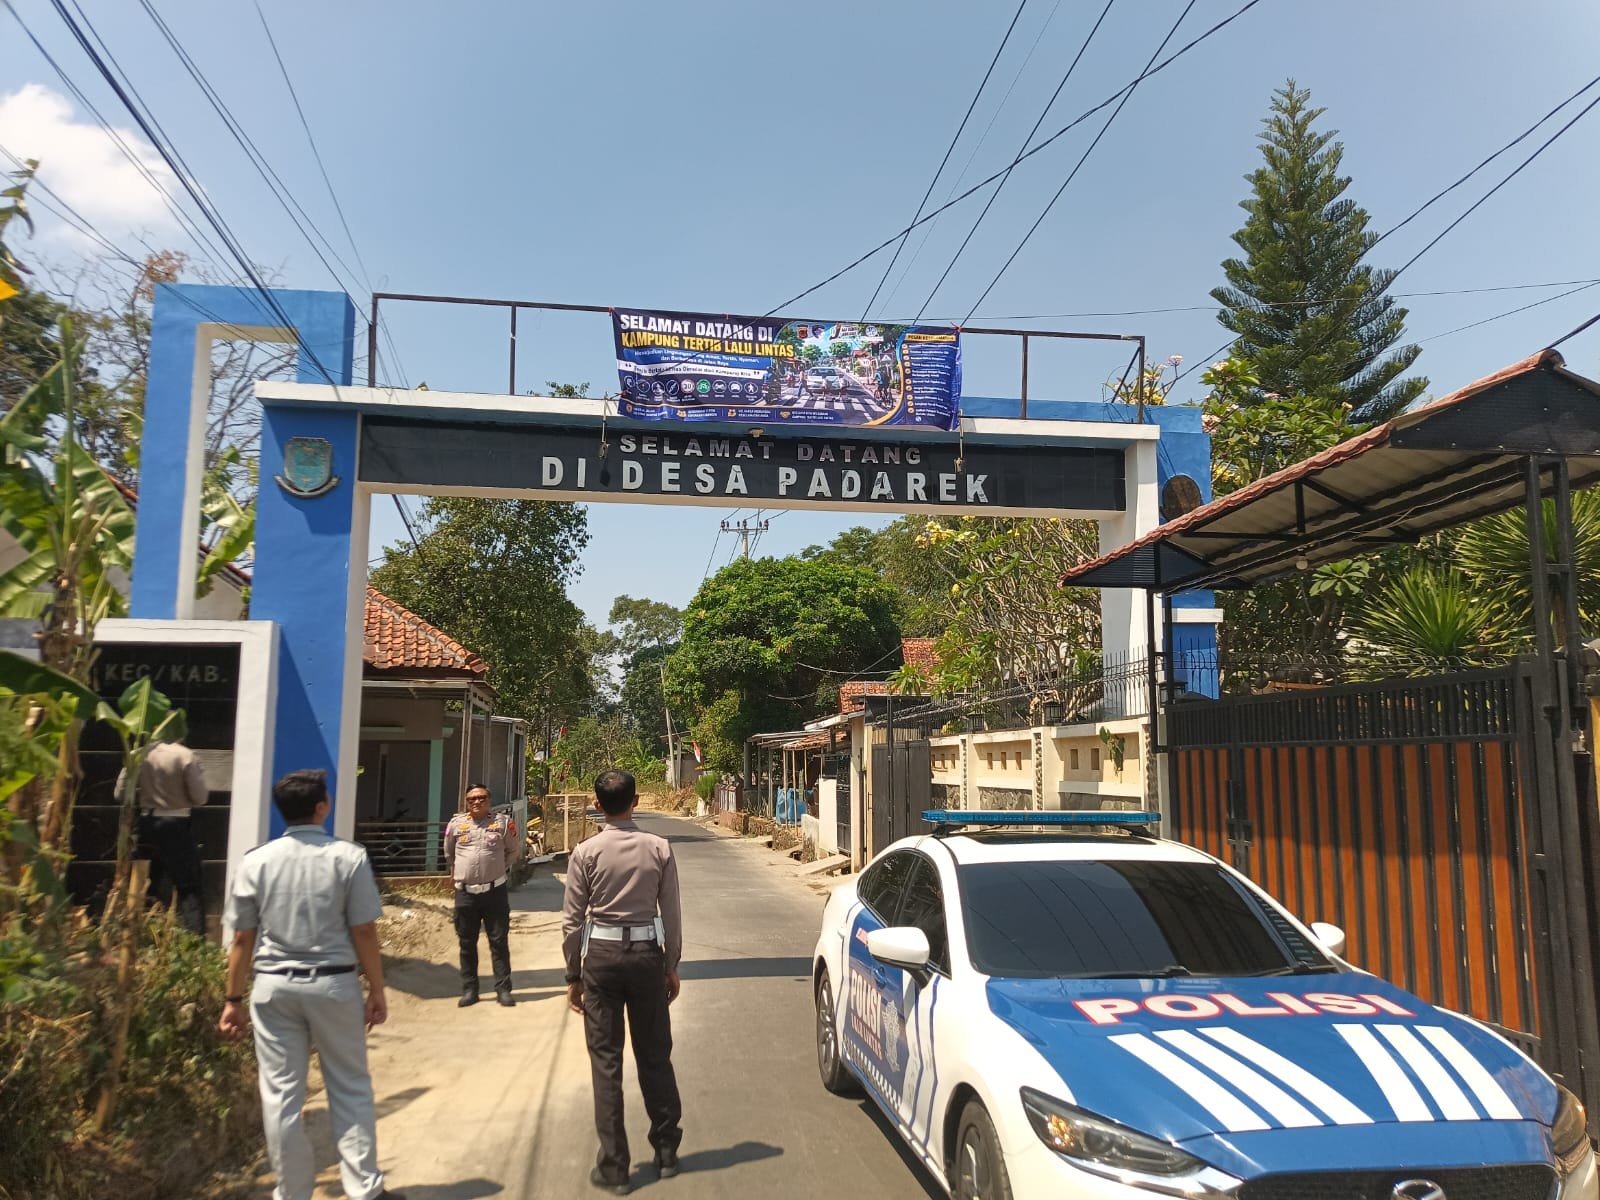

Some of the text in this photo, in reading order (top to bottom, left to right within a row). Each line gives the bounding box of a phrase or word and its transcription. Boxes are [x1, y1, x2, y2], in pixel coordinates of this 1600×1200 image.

[620, 315, 773, 342] SELAMAT DATANG DI
[621, 331, 795, 359] KAMPUNG TERTIB LALU LINTAS
[620, 434, 922, 465] SELAMAT DATANG
[541, 456, 989, 504] DI DESA PADAREK
[851, 968, 882, 1040] POLISI
[1072, 992, 1418, 1025] POLISI
